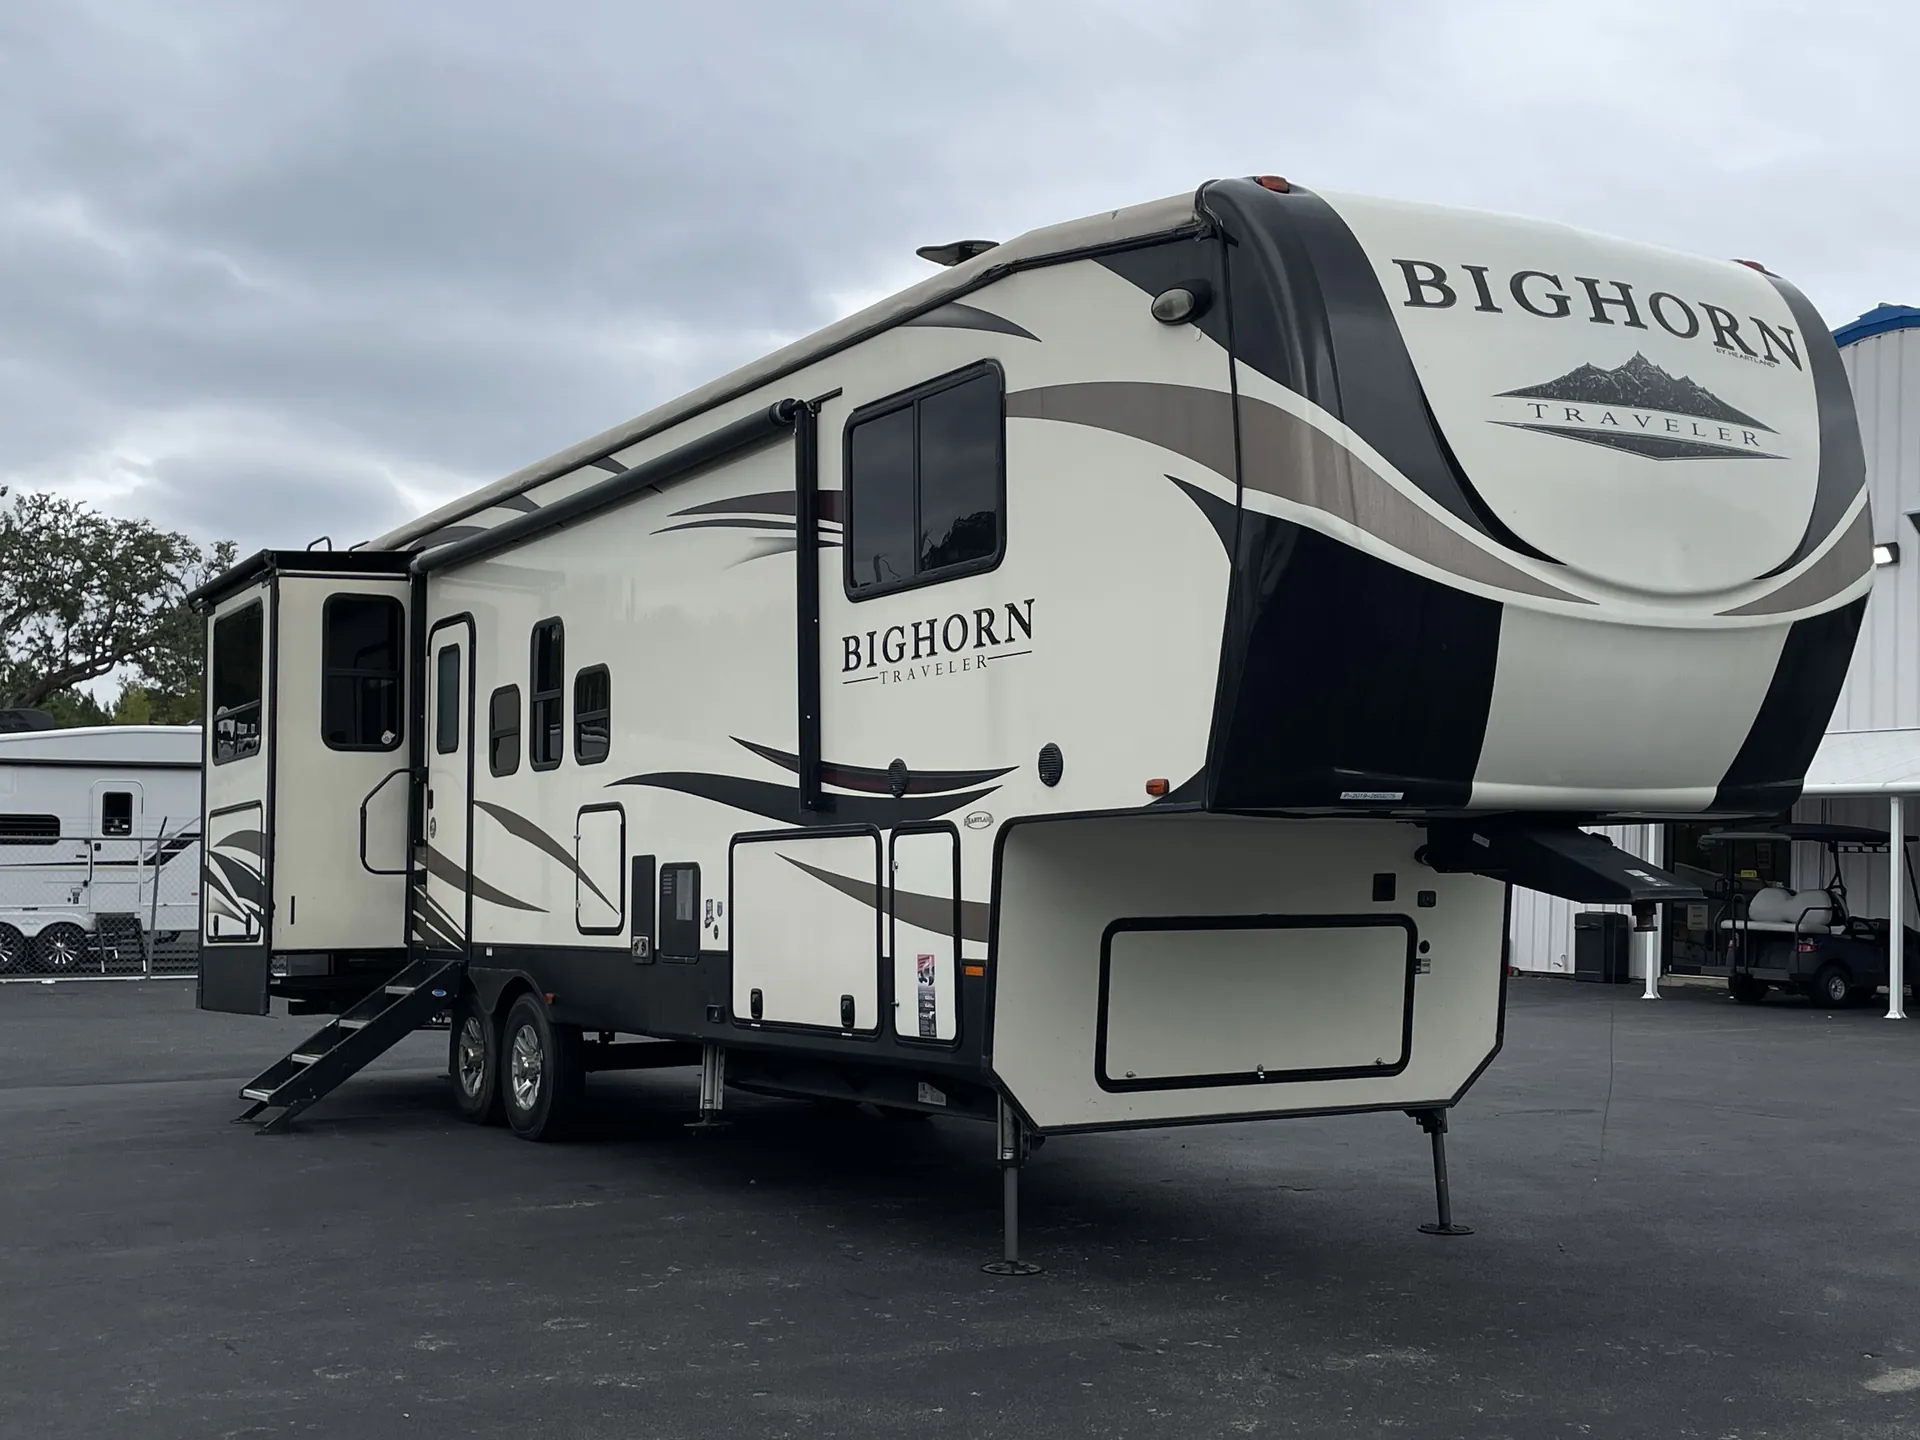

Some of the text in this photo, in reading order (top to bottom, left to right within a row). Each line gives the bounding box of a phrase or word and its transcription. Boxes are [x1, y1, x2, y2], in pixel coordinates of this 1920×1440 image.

[1391, 258, 1802, 372] BIGHORN
[1716, 347, 1776, 368] BY HEARTLAND
[1527, 402, 1761, 446] TRAVELER
[842, 598, 1035, 673] BIGHORN
[880, 654, 987, 684] TRAVELER
